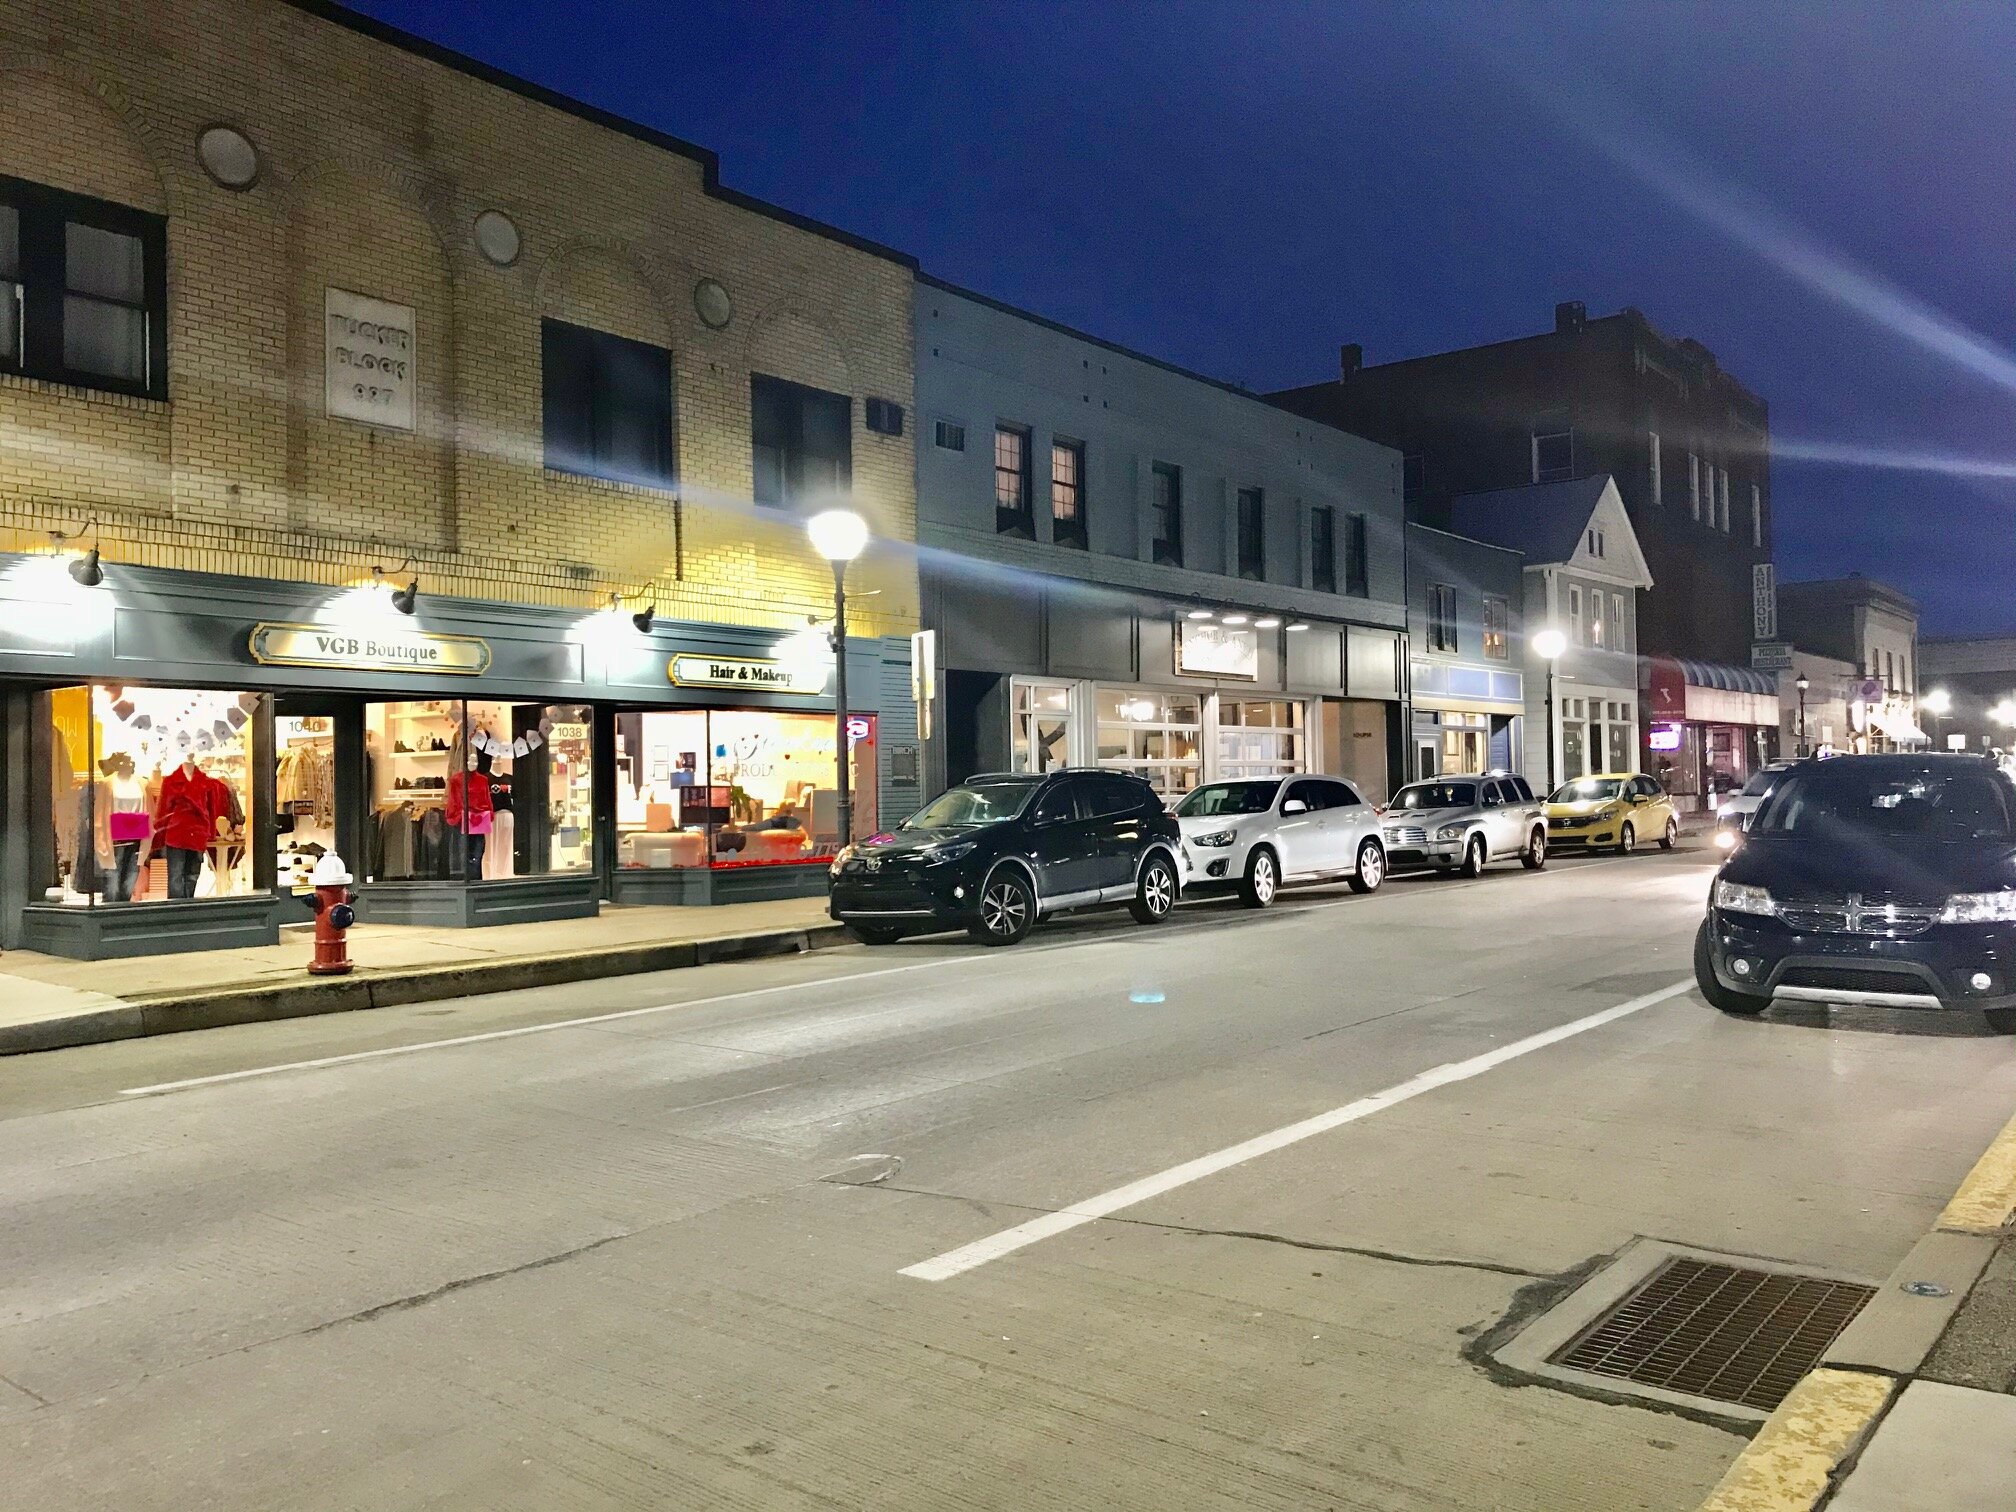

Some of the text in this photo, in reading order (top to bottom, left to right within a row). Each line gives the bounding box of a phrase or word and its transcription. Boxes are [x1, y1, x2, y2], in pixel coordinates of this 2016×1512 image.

[335, 346, 407, 381] BLOCK
[1755, 566, 1766, 636] ANTHONY
[316, 636, 438, 663] VGB Boutique
[710, 664, 793, 687] Hair & Makeup
[289, 720, 322, 733] 1040
[557, 727, 582, 737] 1038
